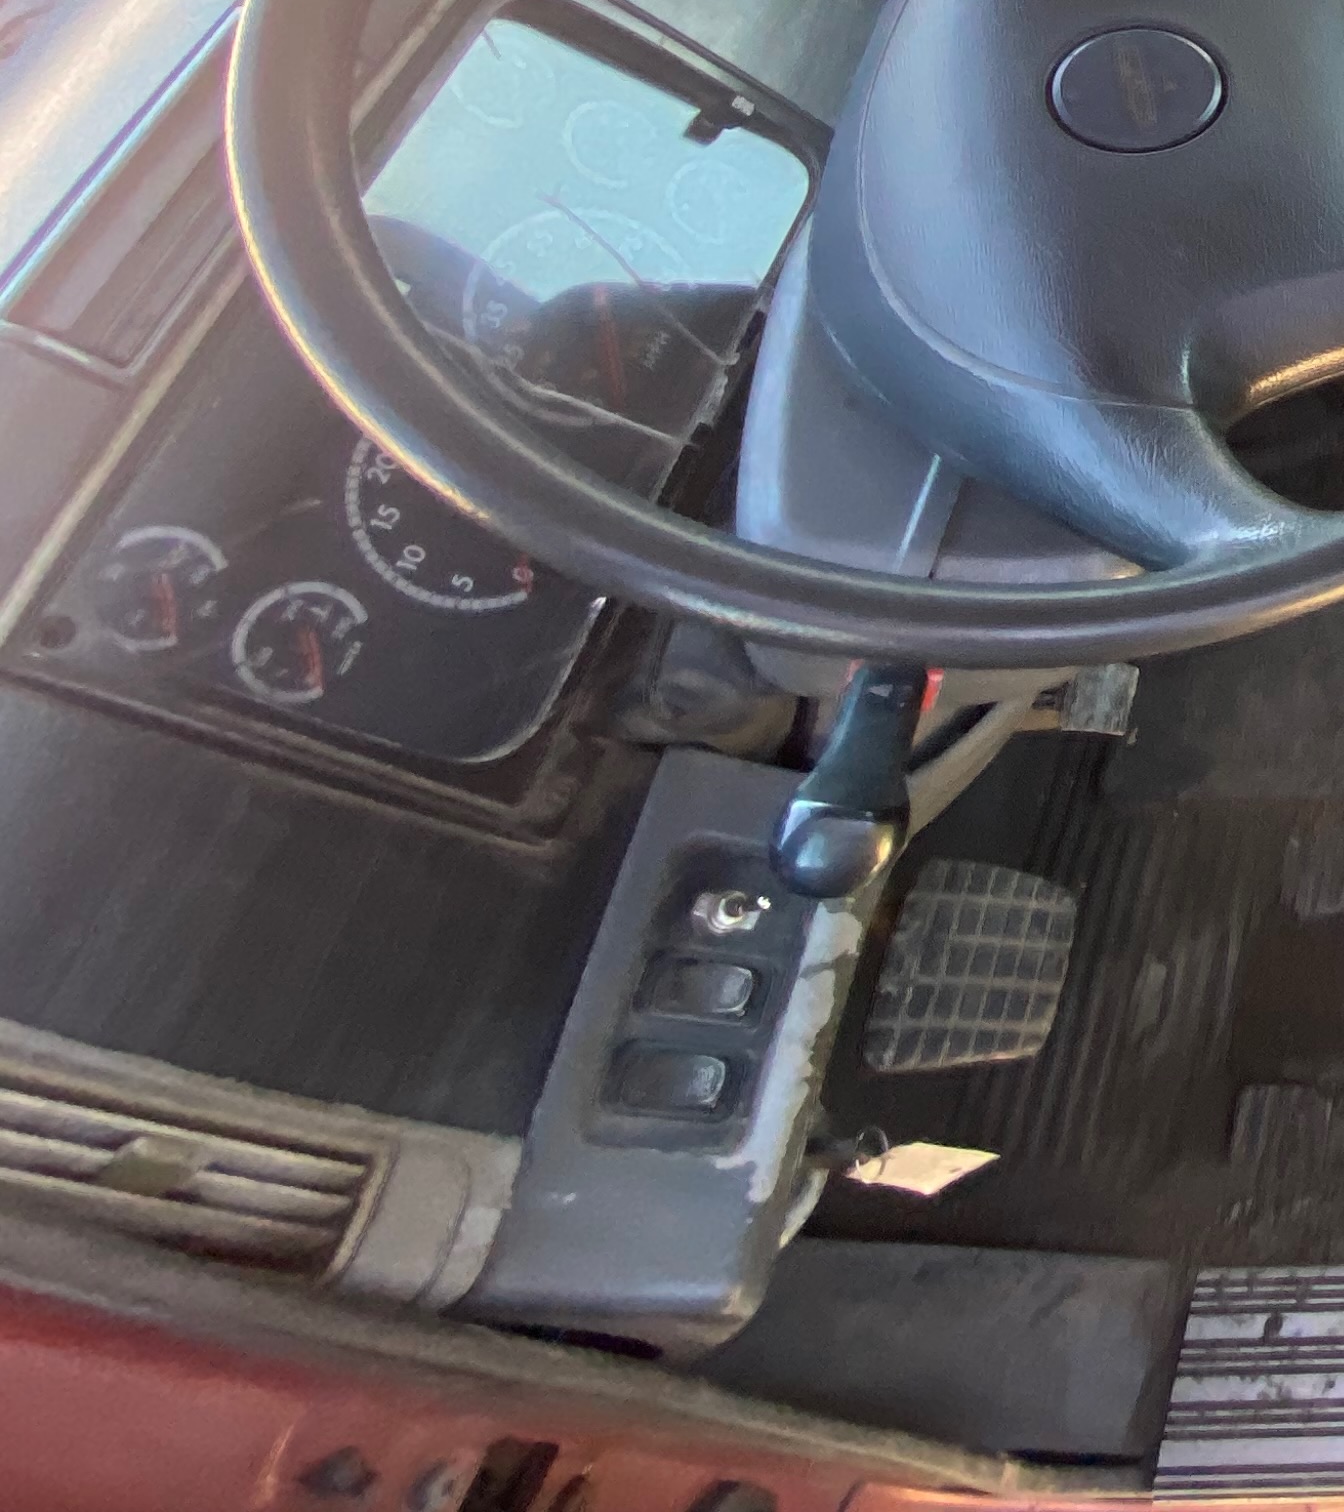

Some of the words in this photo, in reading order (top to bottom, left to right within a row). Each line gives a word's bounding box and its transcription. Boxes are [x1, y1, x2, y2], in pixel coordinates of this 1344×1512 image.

[367, 452, 402, 485] 20
[371, 504, 400, 531] 15
[396, 544, 426, 571] 10
[452, 574, 474, 593] 5
